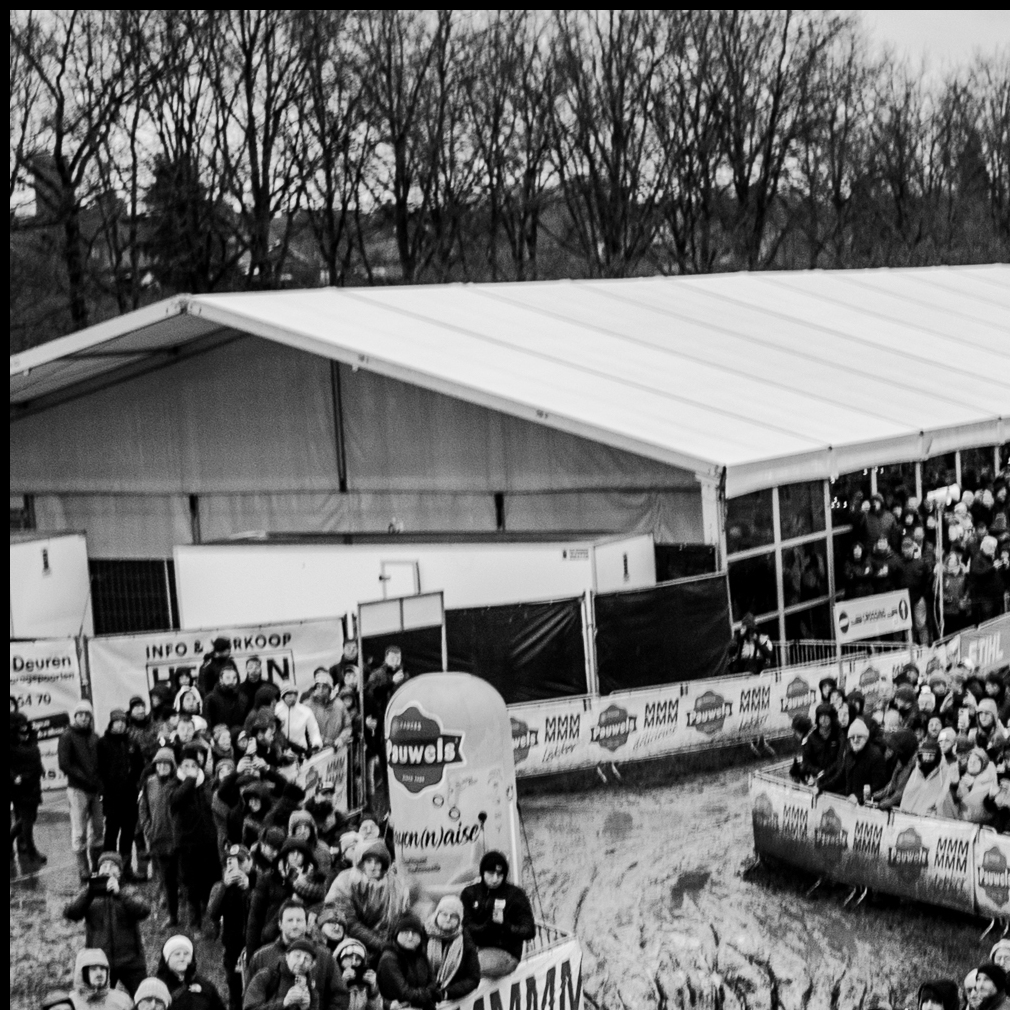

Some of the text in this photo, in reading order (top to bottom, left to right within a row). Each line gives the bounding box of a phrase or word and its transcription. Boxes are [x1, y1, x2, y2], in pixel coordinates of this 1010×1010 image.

[146, 642, 187, 659] INFO
[194, 639, 203, 654] &
[13, 655, 71, 672] Deuren
[645, 698, 679, 715] MMM
[690, 702, 732, 724] Pauwels
[545, 713, 580, 731] MMM
[595, 717, 637, 740] Pauwels
[386, 737, 456, 764] Pauwels
[889, 847, 929, 866] Pauwels
[936, 837, 969, 858] MMM
